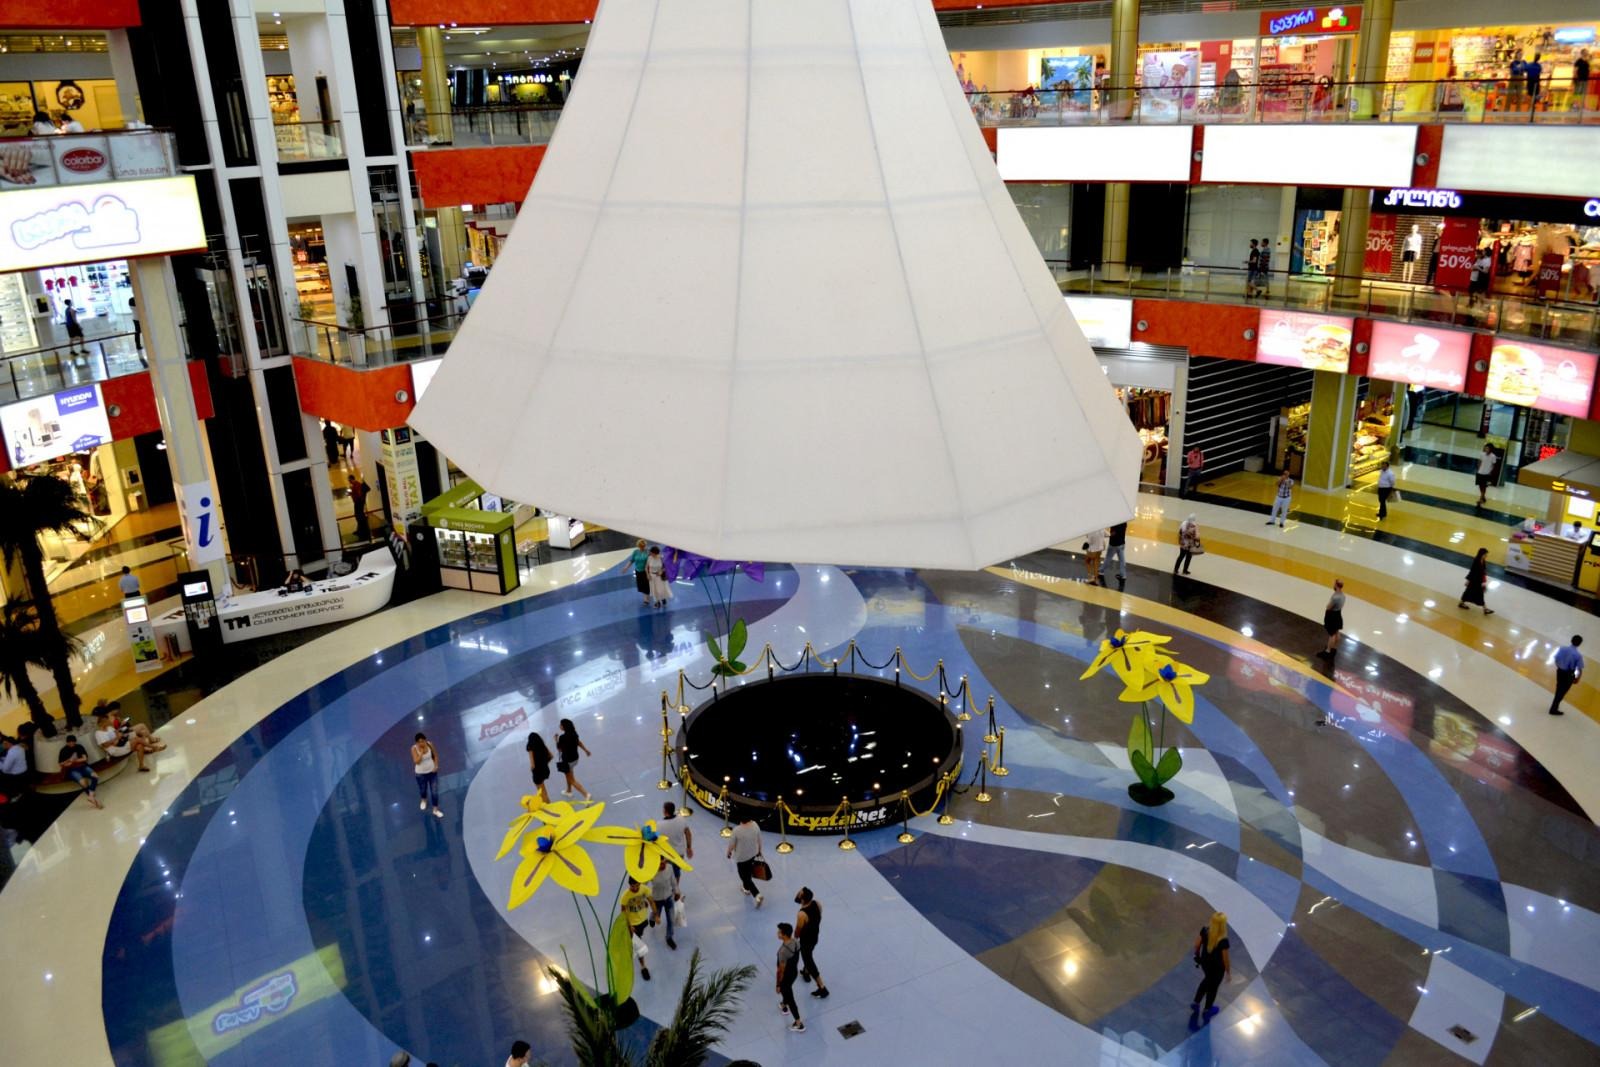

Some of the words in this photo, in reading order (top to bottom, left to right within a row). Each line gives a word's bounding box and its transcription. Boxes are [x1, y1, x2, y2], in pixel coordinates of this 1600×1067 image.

[1439, 254, 1473, 270] 50%
[223, 615, 251, 630] TM
[253, 610, 305, 626] CUSTOMER
[307, 604, 345, 616] SERVICE
